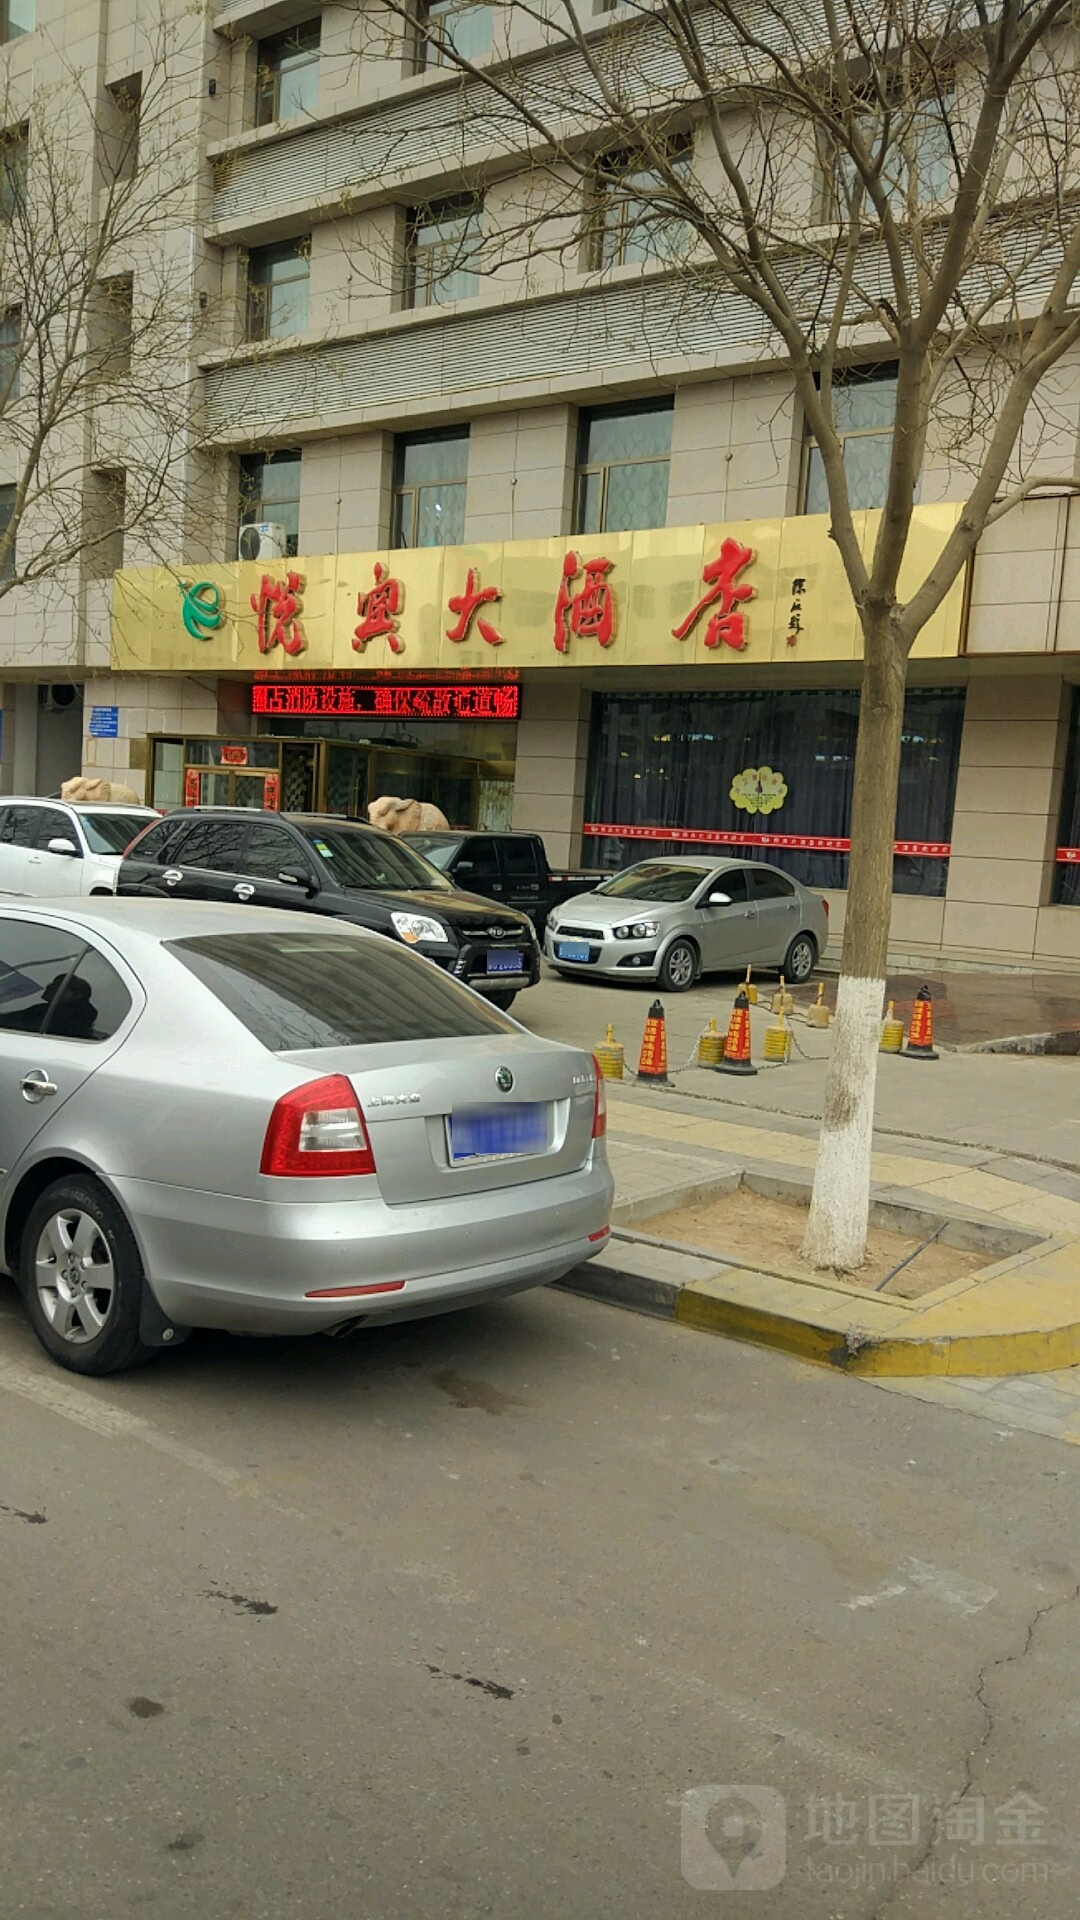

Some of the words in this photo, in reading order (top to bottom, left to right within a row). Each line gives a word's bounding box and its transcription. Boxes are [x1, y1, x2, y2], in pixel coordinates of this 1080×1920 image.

[250, 538, 756, 655] 悦宾大酒店
